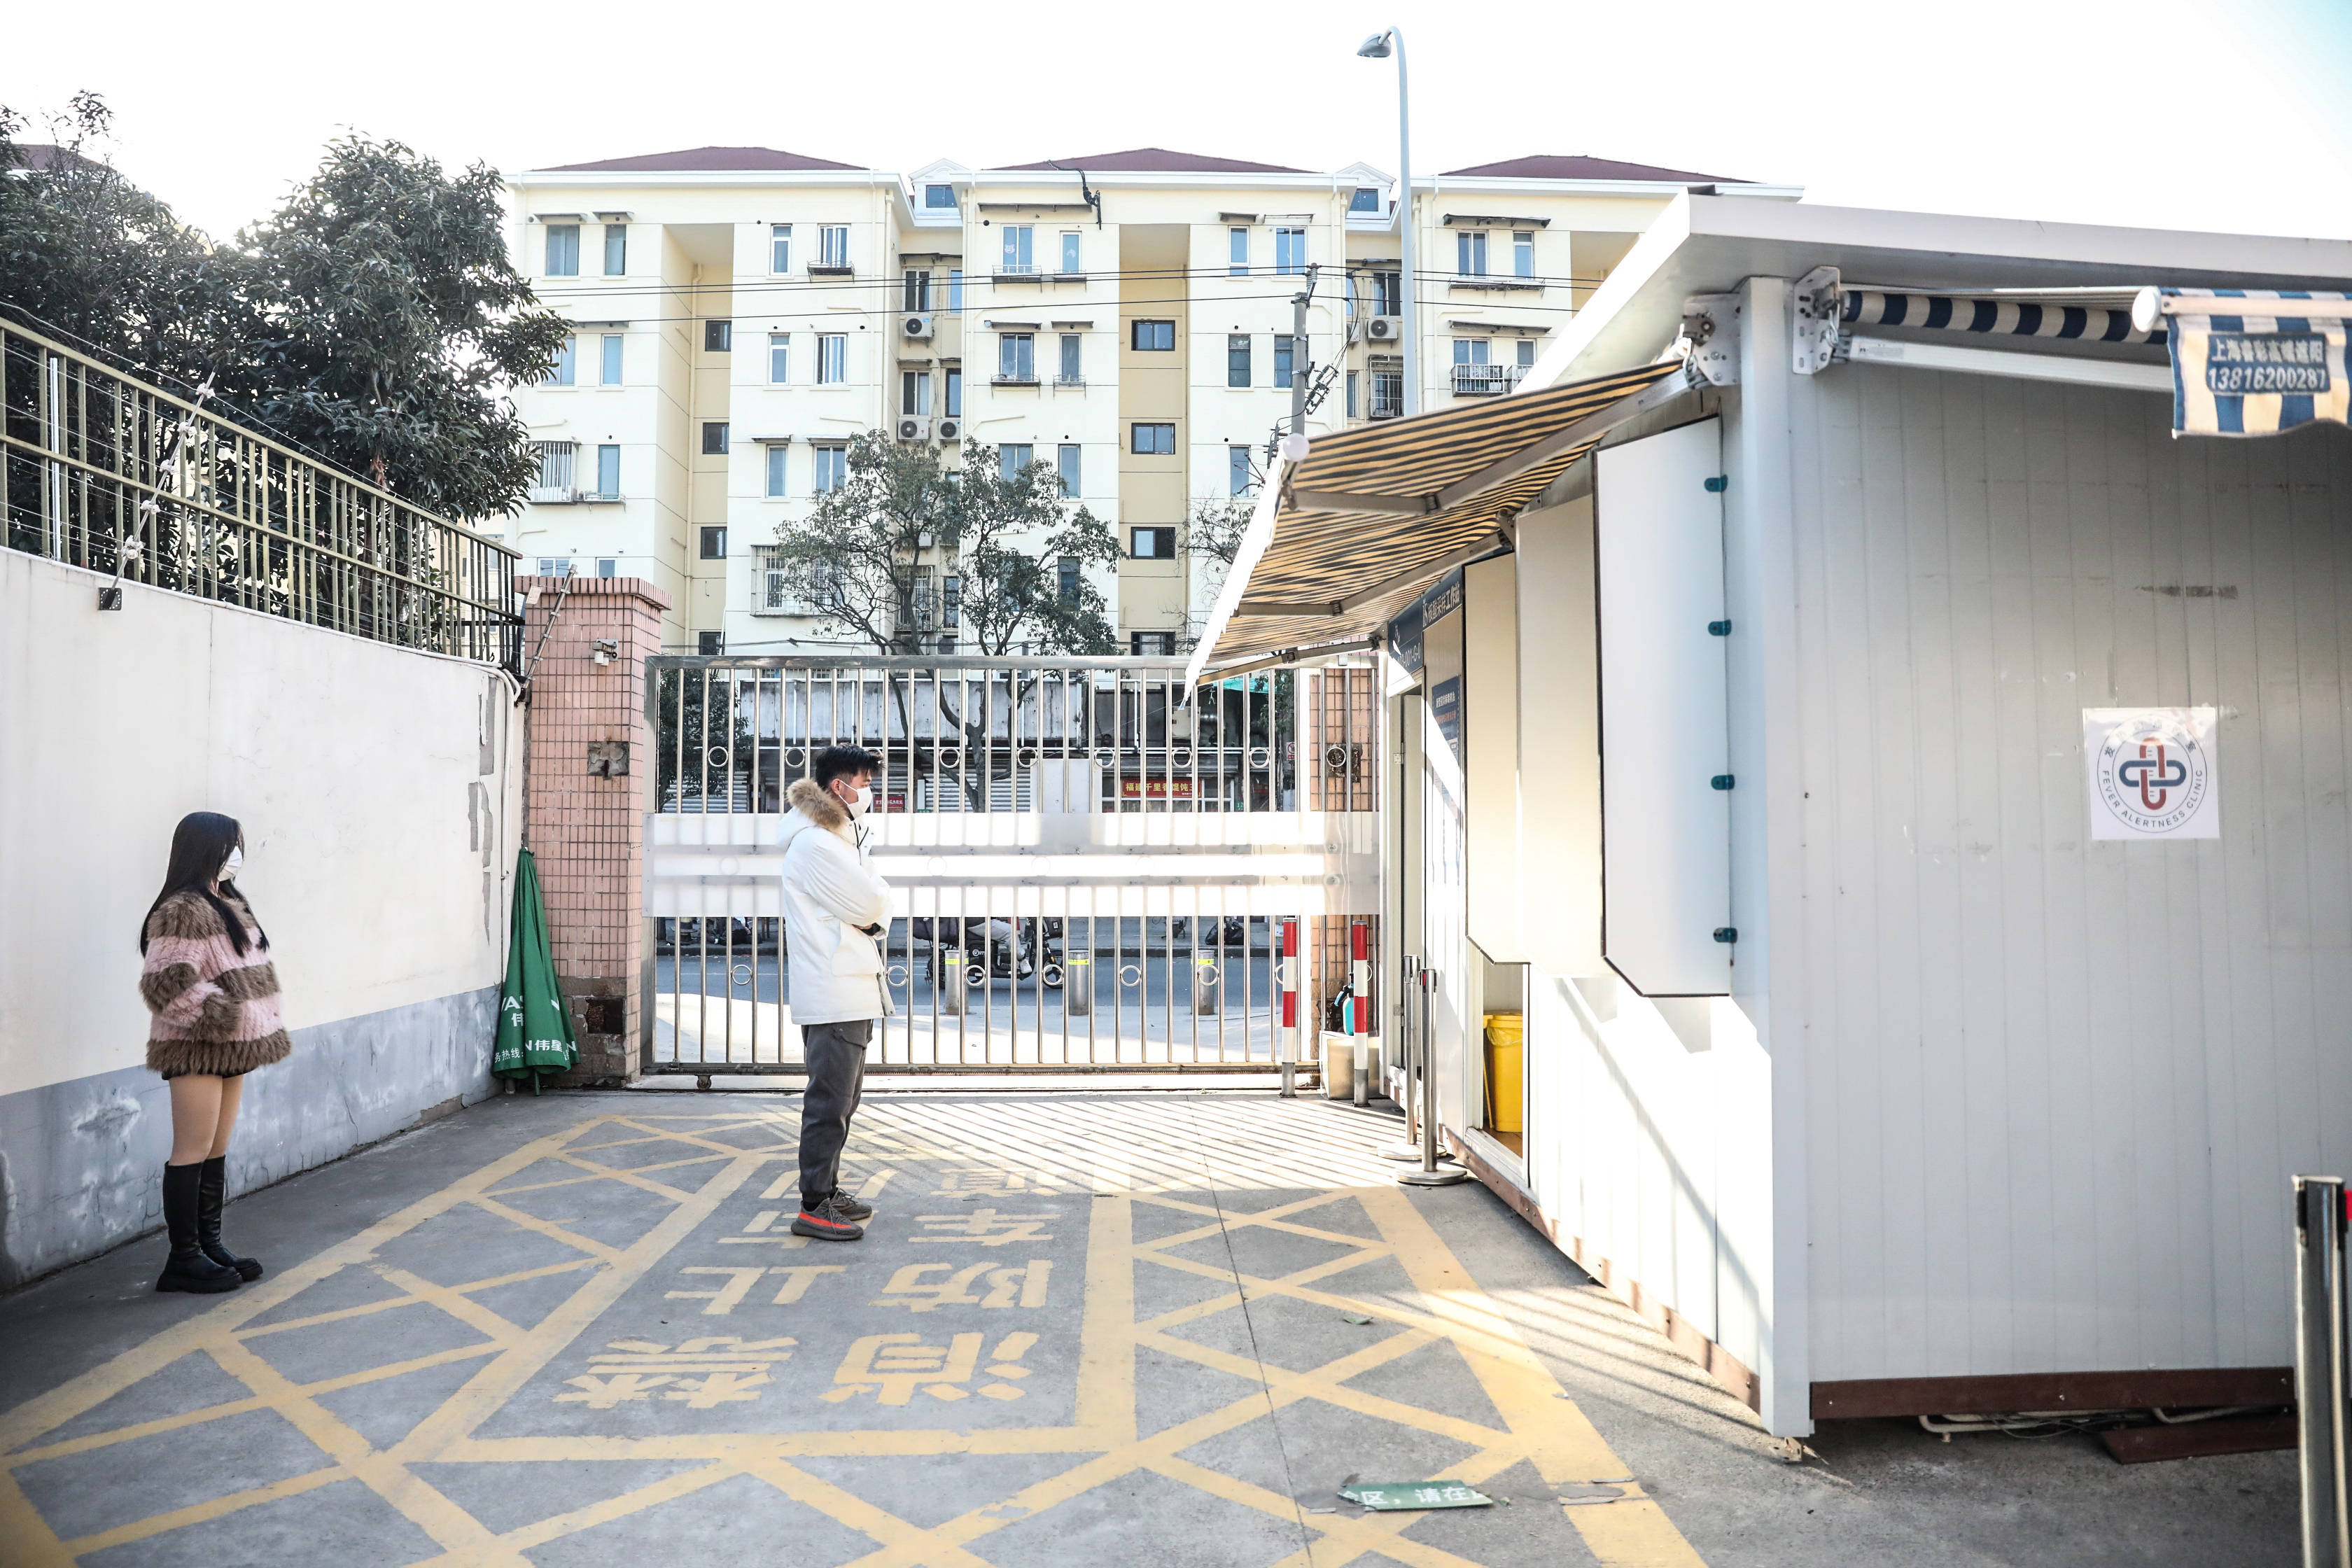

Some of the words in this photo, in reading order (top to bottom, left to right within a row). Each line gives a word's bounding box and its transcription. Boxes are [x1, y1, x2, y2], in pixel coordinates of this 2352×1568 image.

[2208, 366, 2325, 390] 13816200287
[2102, 770, 2120, 808] FEVER
[2121, 810, 2186, 827] ALERTNESS
[2186, 770, 2203, 808] CLINIC
[535, 1040, 563, 1052] 伟星
